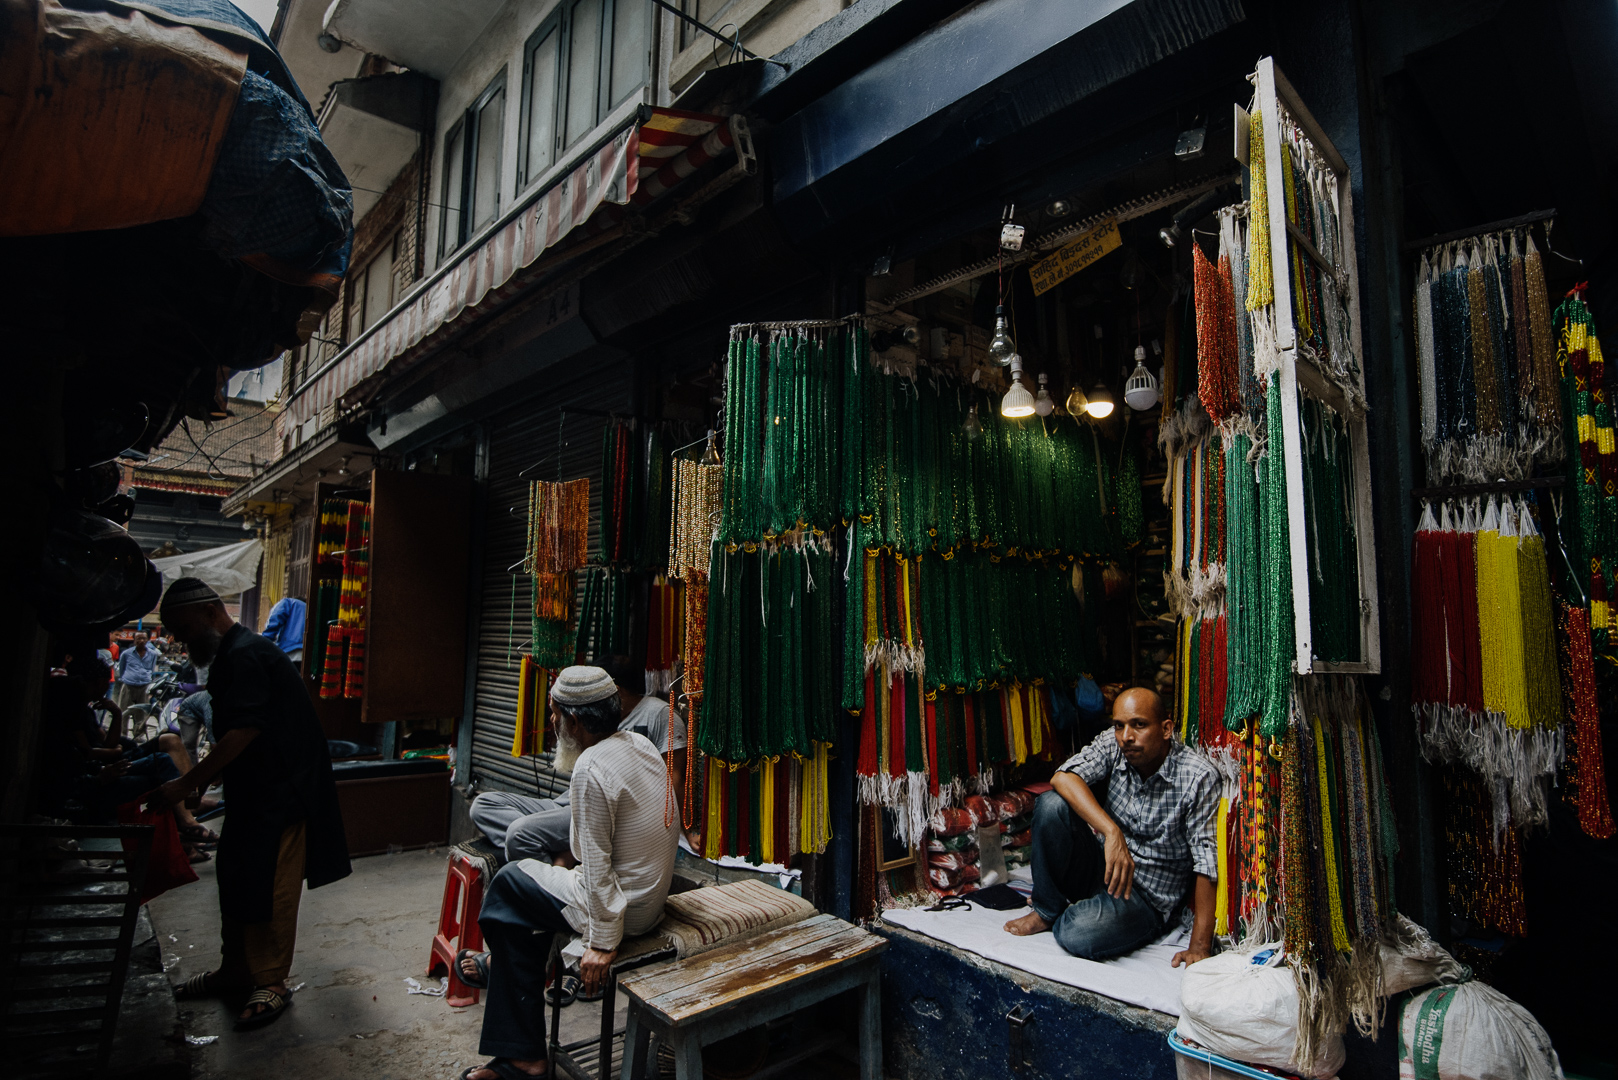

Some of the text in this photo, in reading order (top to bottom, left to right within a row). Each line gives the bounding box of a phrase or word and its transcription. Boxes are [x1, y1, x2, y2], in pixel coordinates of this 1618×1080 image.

[1031, 255, 1059, 279] साहिद
[1091, 221, 1115, 242] स्टोर
[1417, 1018, 1427, 1047] BRAND
[1421, 1008, 1442, 1064] Yashodha
